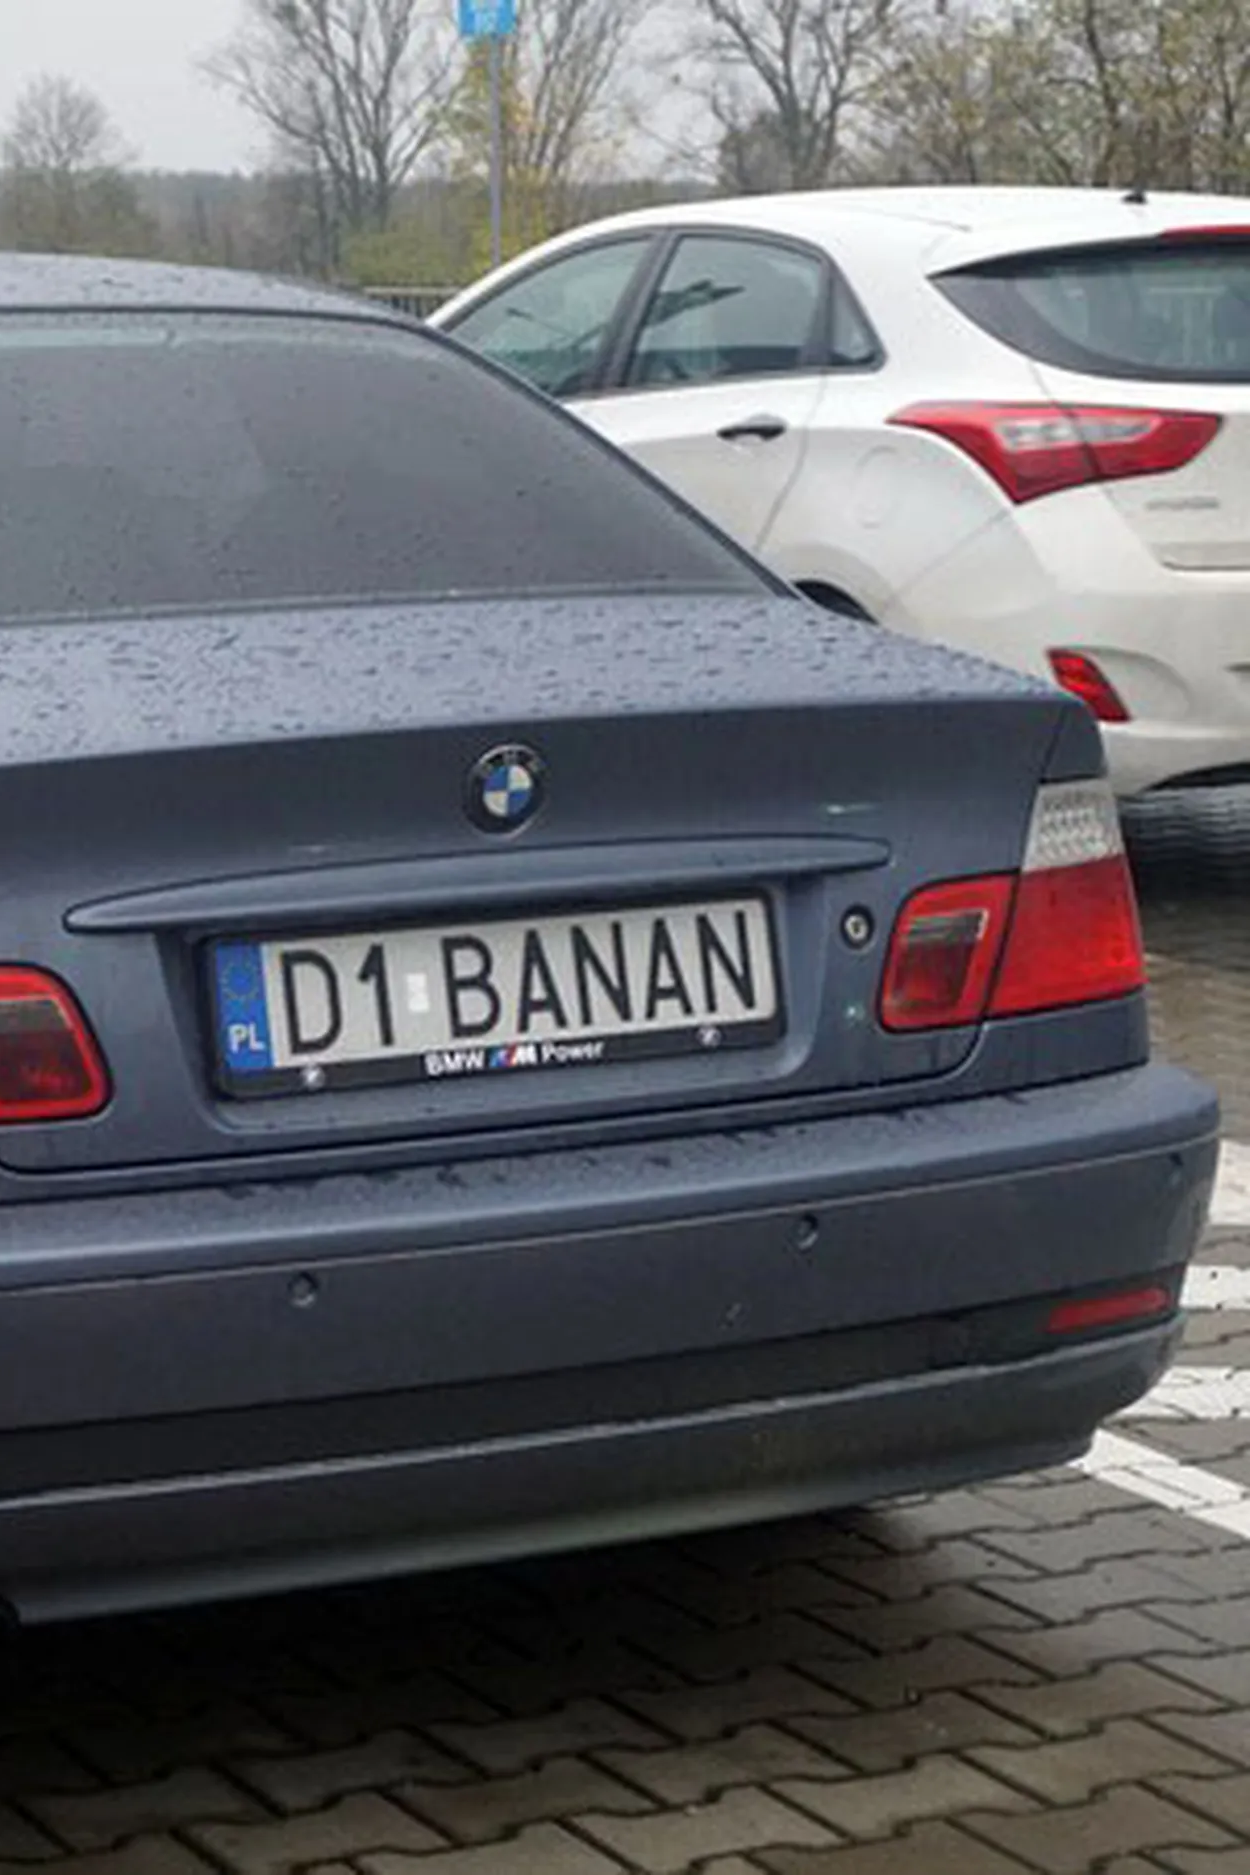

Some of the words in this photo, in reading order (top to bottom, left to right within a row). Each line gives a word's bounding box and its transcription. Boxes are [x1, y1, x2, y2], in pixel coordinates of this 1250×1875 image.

[280, 943, 395, 1055] D1
[441, 910, 756, 1038] BANAN
[228, 1023, 265, 1054] PL
[425, 1049, 484, 1076] BMW
[541, 1041, 605, 1063] Power
